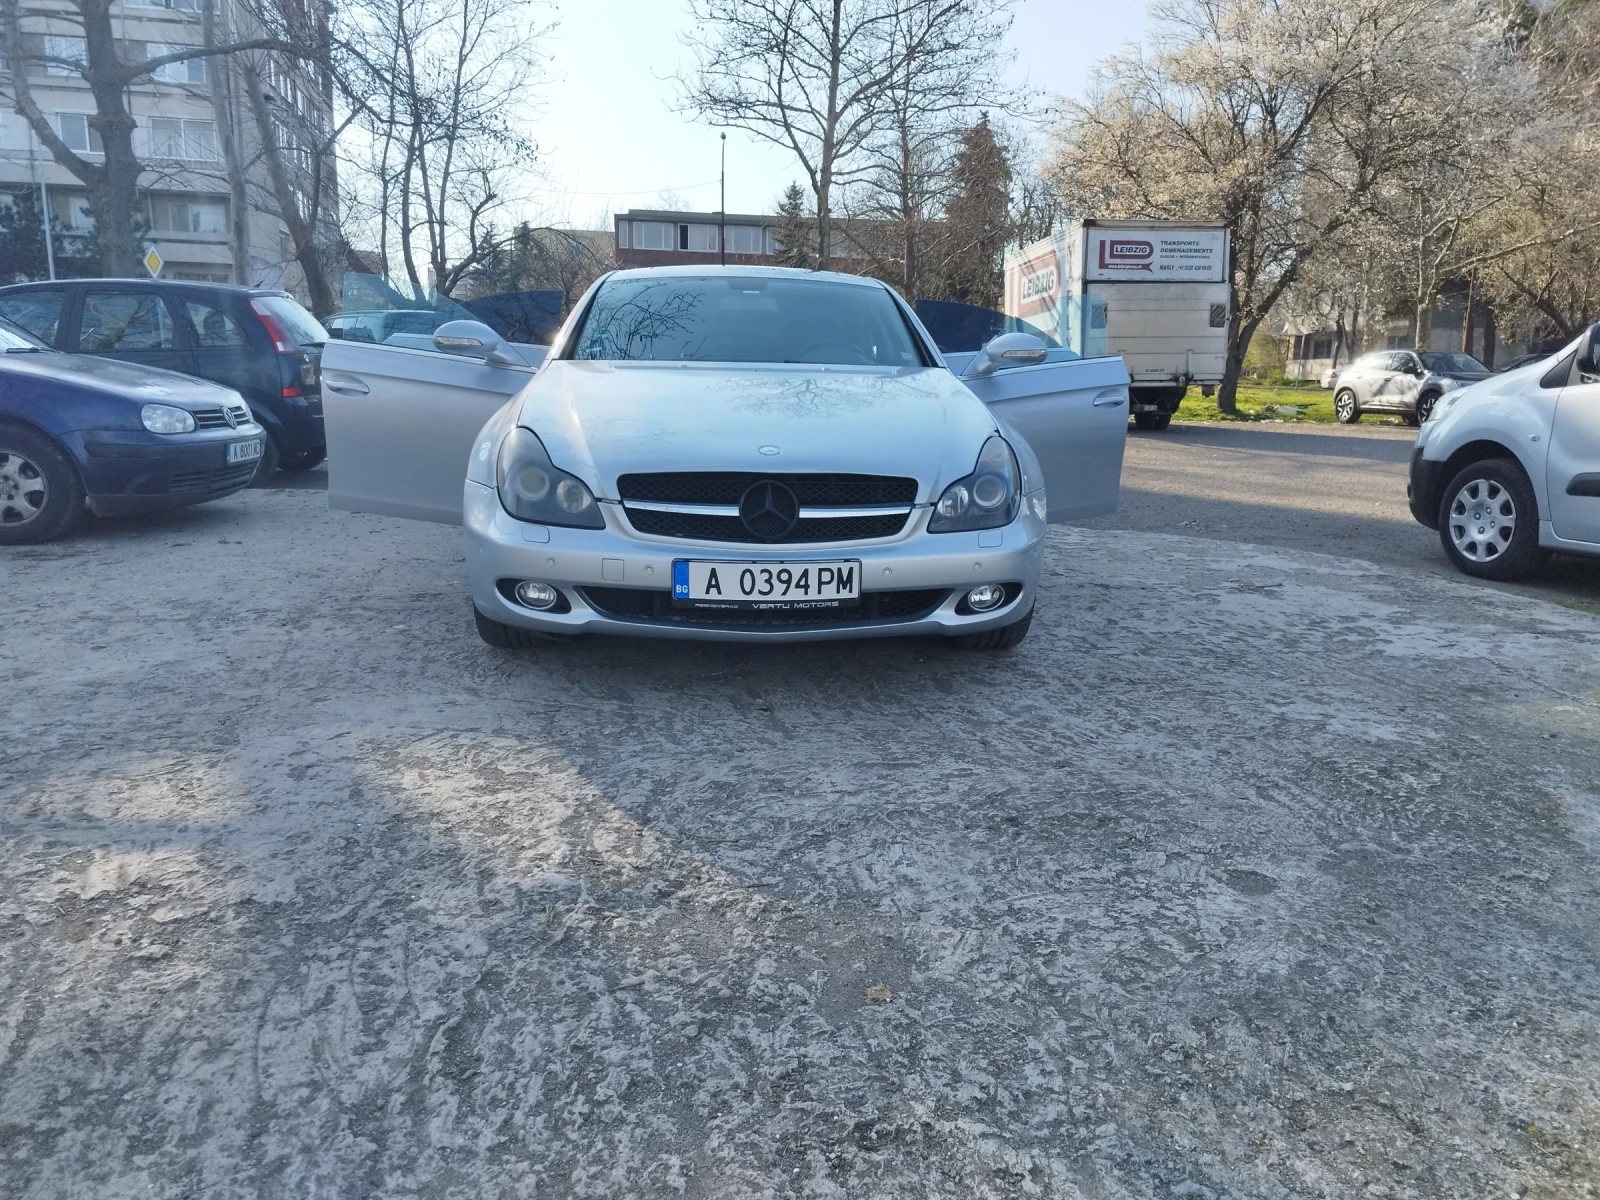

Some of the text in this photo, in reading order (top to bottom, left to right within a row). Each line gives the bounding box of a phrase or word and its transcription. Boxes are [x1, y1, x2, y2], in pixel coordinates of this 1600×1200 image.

[1022, 269, 1055, 300] LEIBZIG
[675, 584, 688, 594] BG
[705, 567, 722, 595] A
[794, 601, 840, 609] MOTORS
